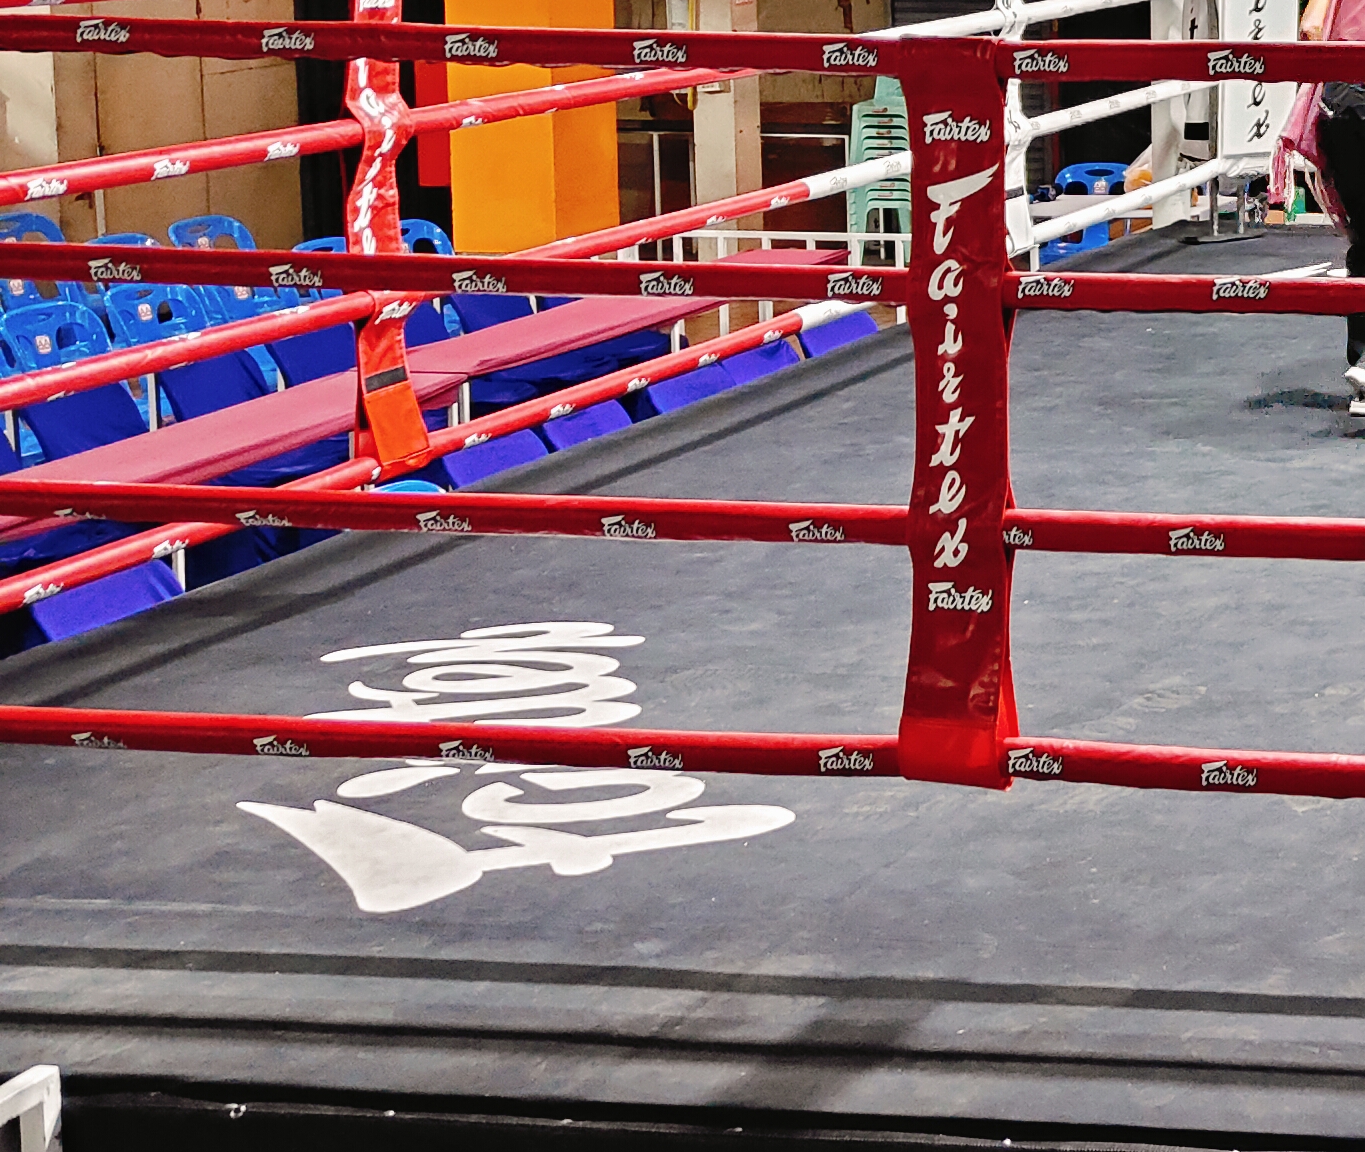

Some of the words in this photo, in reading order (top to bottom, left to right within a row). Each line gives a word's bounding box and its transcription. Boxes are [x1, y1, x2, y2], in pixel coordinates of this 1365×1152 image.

[76, 19, 130, 43] Fairtex
[261, 27, 315, 51] Fairtex
[444, 34, 498, 58] Fairtex
[632, 39, 687, 63] Fairtex
[822, 43, 877, 67] Fairtex
[1013, 50, 1068, 74] Fairtex
[1207, 51, 1265, 75] Fairtex
[923, 112, 991, 143] Fairtex
[88, 258, 142, 282] Fairtex
[269, 264, 323, 288] Fairtex
[452, 270, 507, 293] Fairtex
[639, 272, 694, 296] Fairtex
[826, 272, 881, 296] Fairtex
[1017, 275, 1074, 298] Fairtex
[1212, 279, 1269, 301] Fairtex
[927, 162, 999, 569] Fairtex
[416, 511, 472, 533] Fairtex
[601, 515, 655, 538] Fairtex
[789, 520, 844, 542] Fairtex
[1002, 528, 1033, 546] rtex
[1169, 528, 1224, 552] Fairtex
[928, 581, 992, 612] Fairtex
[253, 735, 309, 757] Fairtex
[439, 741, 494, 762] Fairtex
[627, 747, 683, 769] Fairtex
[819, 747, 874, 771] Fairtex
[1007, 749, 1063, 774] Fairtex
[1201, 761, 1257, 785] Fairtex
